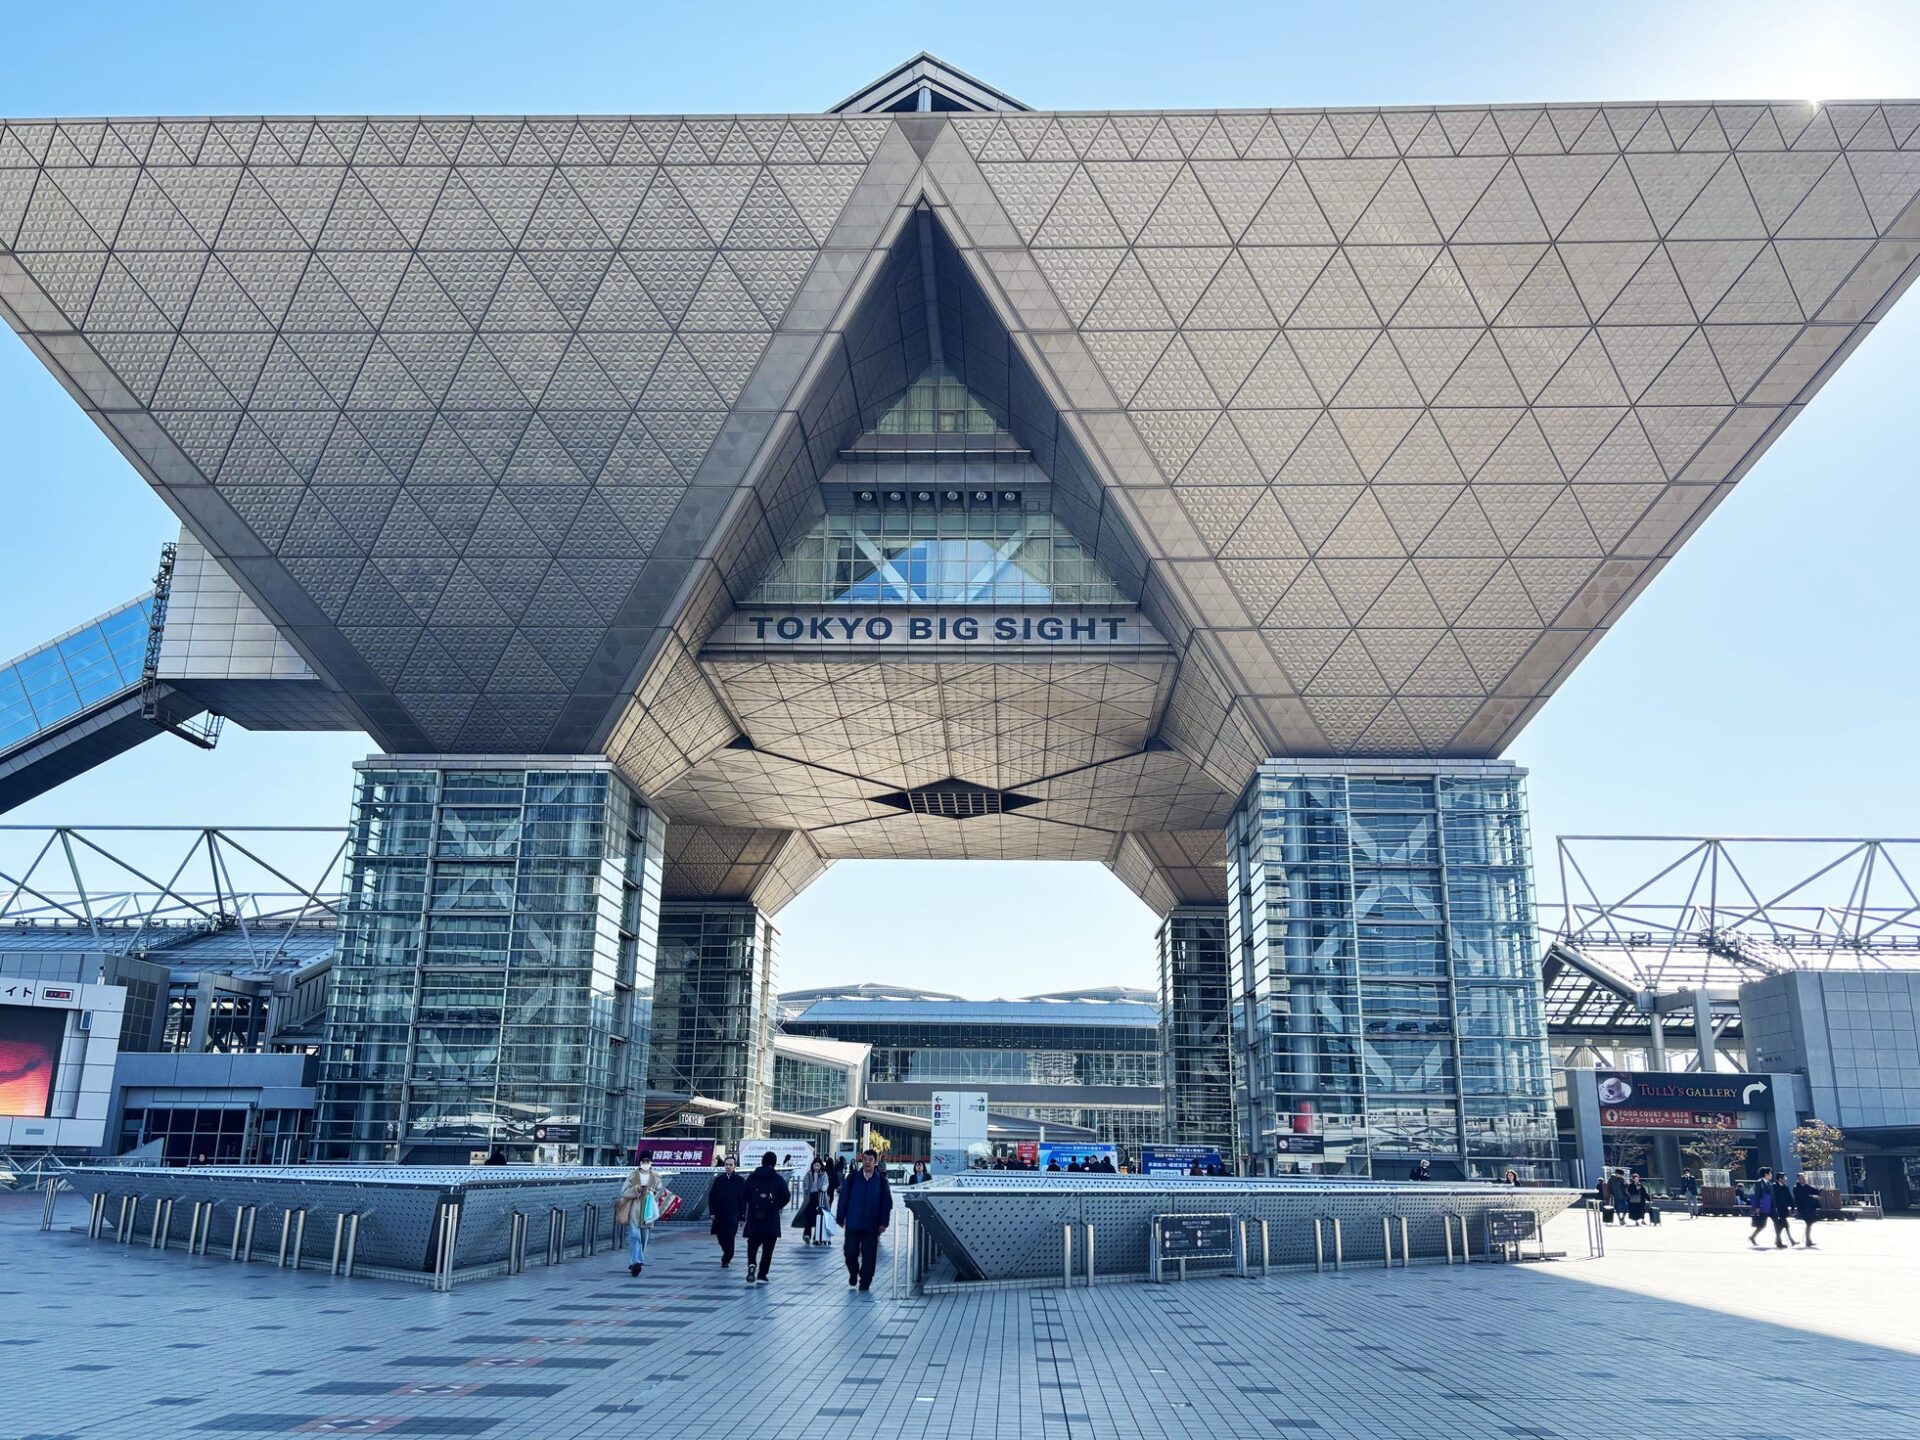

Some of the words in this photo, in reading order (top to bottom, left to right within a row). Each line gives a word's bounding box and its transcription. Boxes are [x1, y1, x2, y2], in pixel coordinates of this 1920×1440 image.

[749, 616, 893, 640] TOKYO
[909, 616, 979, 640] BIG
[994, 616, 1126, 640] SIGHT
[0, 986, 32, 998] イト
[1637, 1083, 1685, 1097] TULLY'S
[1686, 1087, 1738, 1098] GALLERY
[1639, 1110, 1662, 1118] COURT
[652, 1150, 703, 1161] 国際宝飾展
